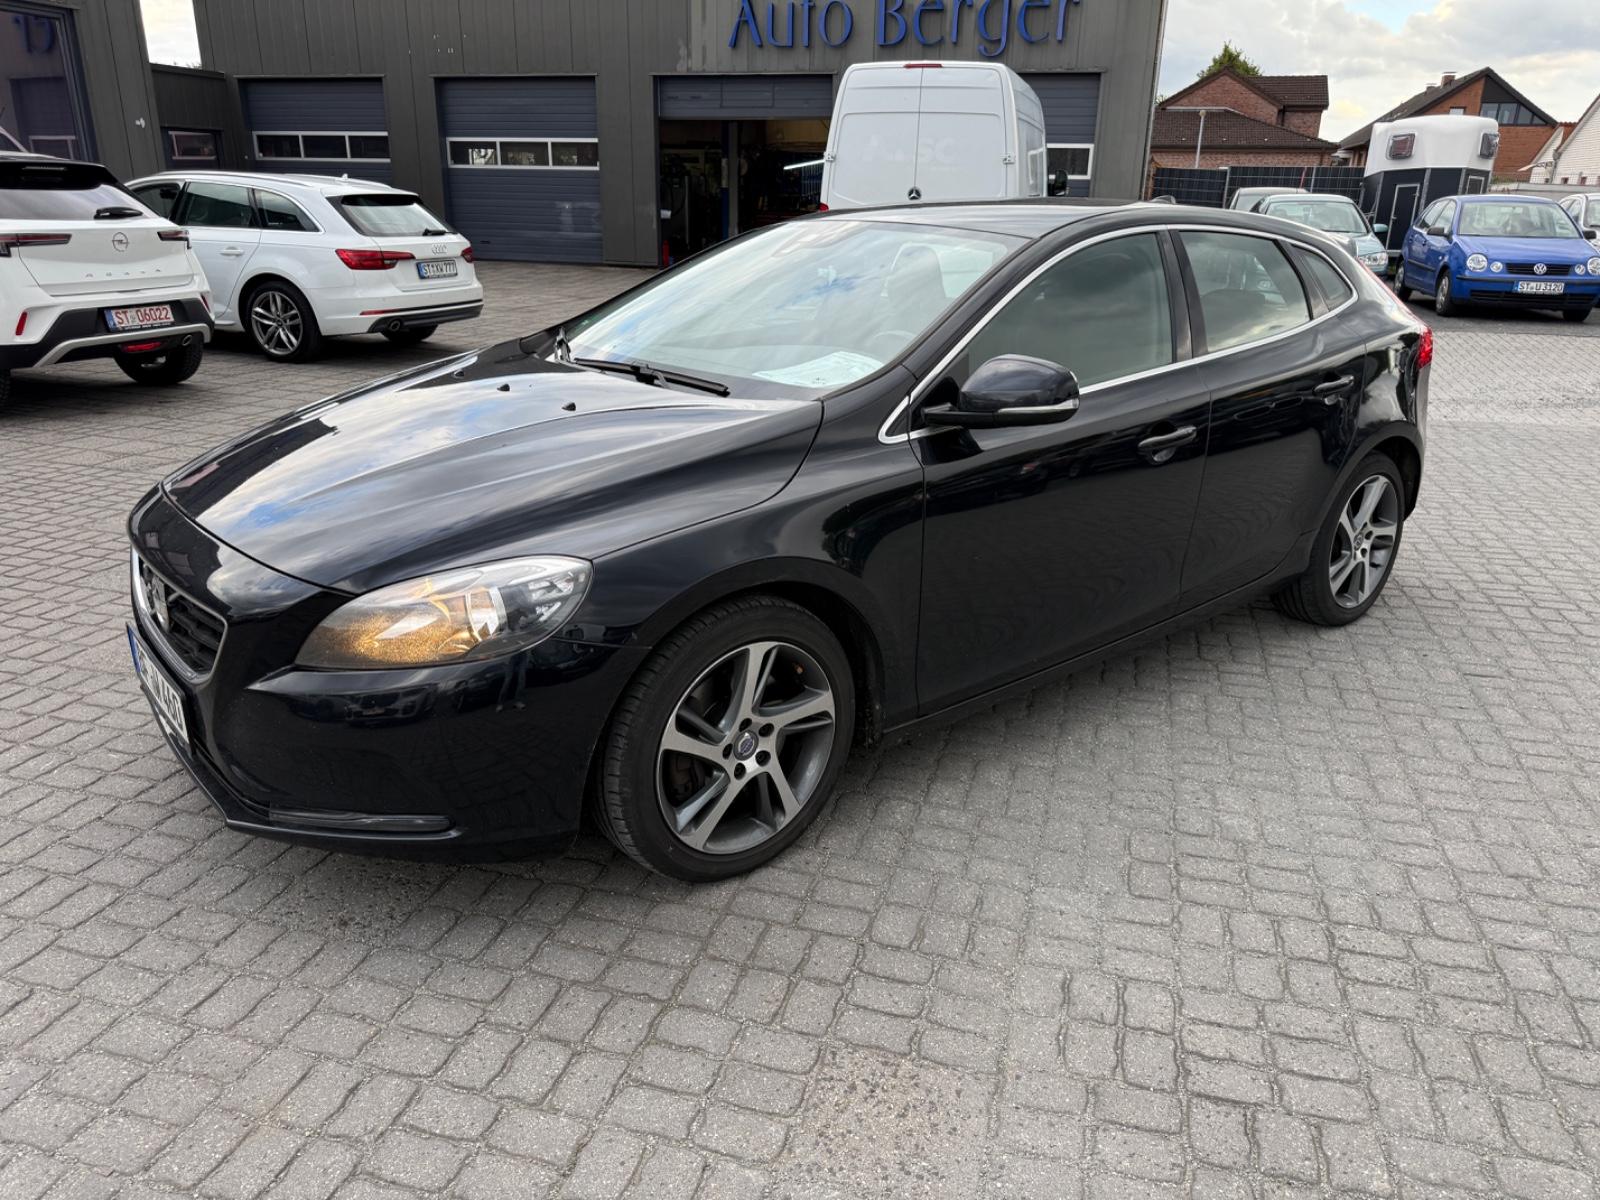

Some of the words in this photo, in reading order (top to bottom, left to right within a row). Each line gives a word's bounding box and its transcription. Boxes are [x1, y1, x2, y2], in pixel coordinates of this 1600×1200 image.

[728, 0, 854, 48] Auto
[875, 0, 1080, 57] Berger
[114, 309, 131, 325] ST
[135, 306, 172, 323] 06022
